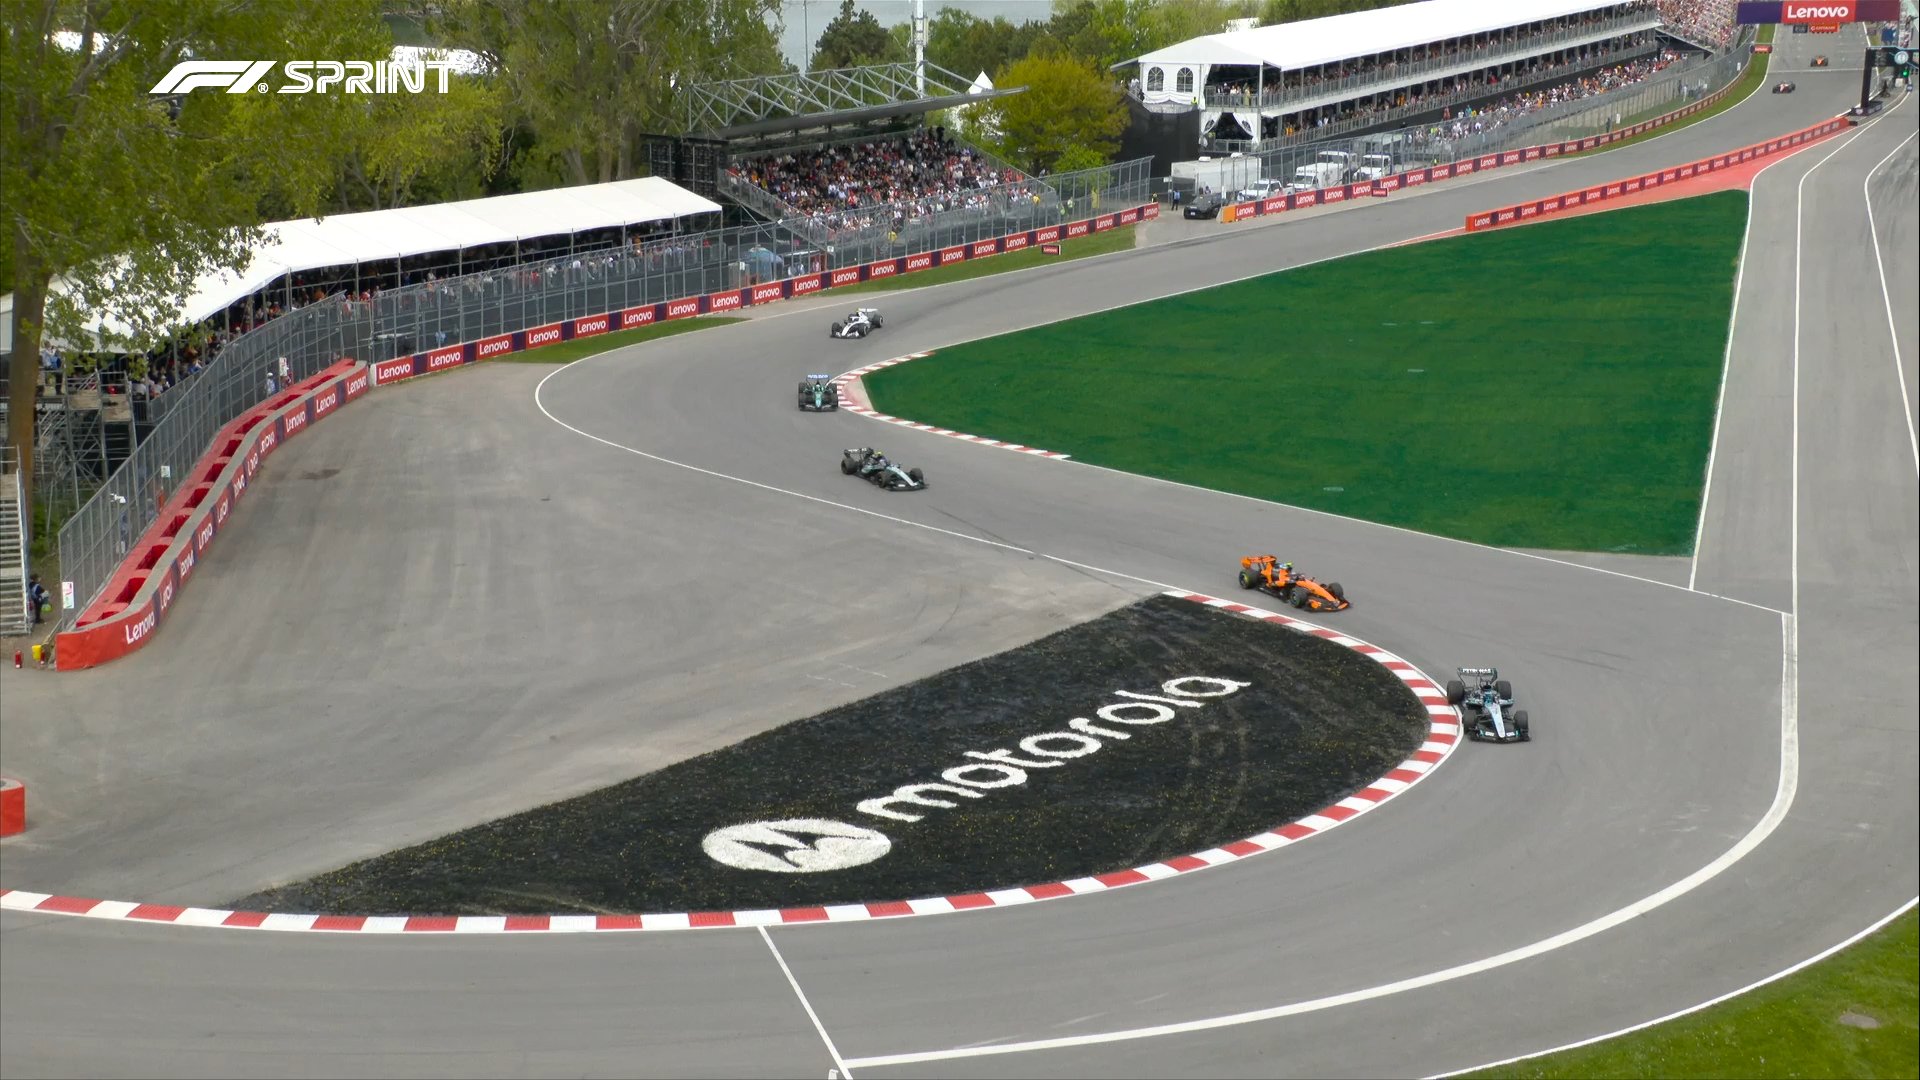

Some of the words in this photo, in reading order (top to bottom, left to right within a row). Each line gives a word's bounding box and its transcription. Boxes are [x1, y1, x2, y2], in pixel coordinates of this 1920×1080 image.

[1787, 5, 1848, 19] Lenovo
[1480, 158, 1496, 168] Lenovo
[1503, 152, 1519, 162] Lenovo
[1432, 167, 1449, 178] Lenovo
[1457, 162, 1472, 173] Lenovo
[1380, 178, 1398, 189] Lenovo
[1407, 172, 1424, 183] Lenovo
[1353, 183, 1371, 195] Lenovo
[1607, 184, 1620, 195] Lenovo
[1627, 179, 1639, 191] Lenovo
[1296, 193, 1315, 205] Lenovo
[1324, 189, 1343, 200] Lenovo
[1565, 194, 1580, 206] Lenovo
[1586, 189, 1600, 200] Lenovo
[1236, 204, 1254, 217] Lenovo
[1266, 199, 1285, 210] Lenovo
[1521, 205, 1537, 216] Lenovo
[1544, 200, 1558, 211] Lenovo
[1143, 205, 1159, 217] Lenovo
[1498, 209, 1514, 221] Lenovo
[1096, 218, 1113, 229] Lenovo
[1121, 212, 1137, 223] Lenovo
[1474, 215, 1491, 227] Lenovo
[1068, 224, 1087, 235] Lenovo
[1006, 236, 1027, 248] Lenovo
[1037, 230, 1058, 242] Lenovo
[974, 243, 995, 255] Lenovo
[942, 249, 963, 262] Lenovo
[907, 256, 930, 269] Lenovo
[871, 263, 895, 276] Lenovo
[833, 270, 858, 283] Lenovo
[794, 278, 820, 291] Lenovo
[754, 286, 780, 300] Lenovo
[712, 295, 739, 308] Lenovo
[668, 302, 697, 316] Lenovo
[624, 310, 652, 325] Lenovo
[576, 319, 606, 334] Lenovo
[528, 328, 559, 344] Lenovo
[479, 339, 510, 355] Lenovo
[430, 351, 461, 367] Lenovo
[379, 362, 411, 380] Lenovo
[346, 375, 367, 395] Lenovo
[316, 392, 336, 413] Lenovo
[285, 410, 306, 433] Lenovo
[125, 611, 155, 645] Lenovo
[856, 676, 1251, 823] motorola
